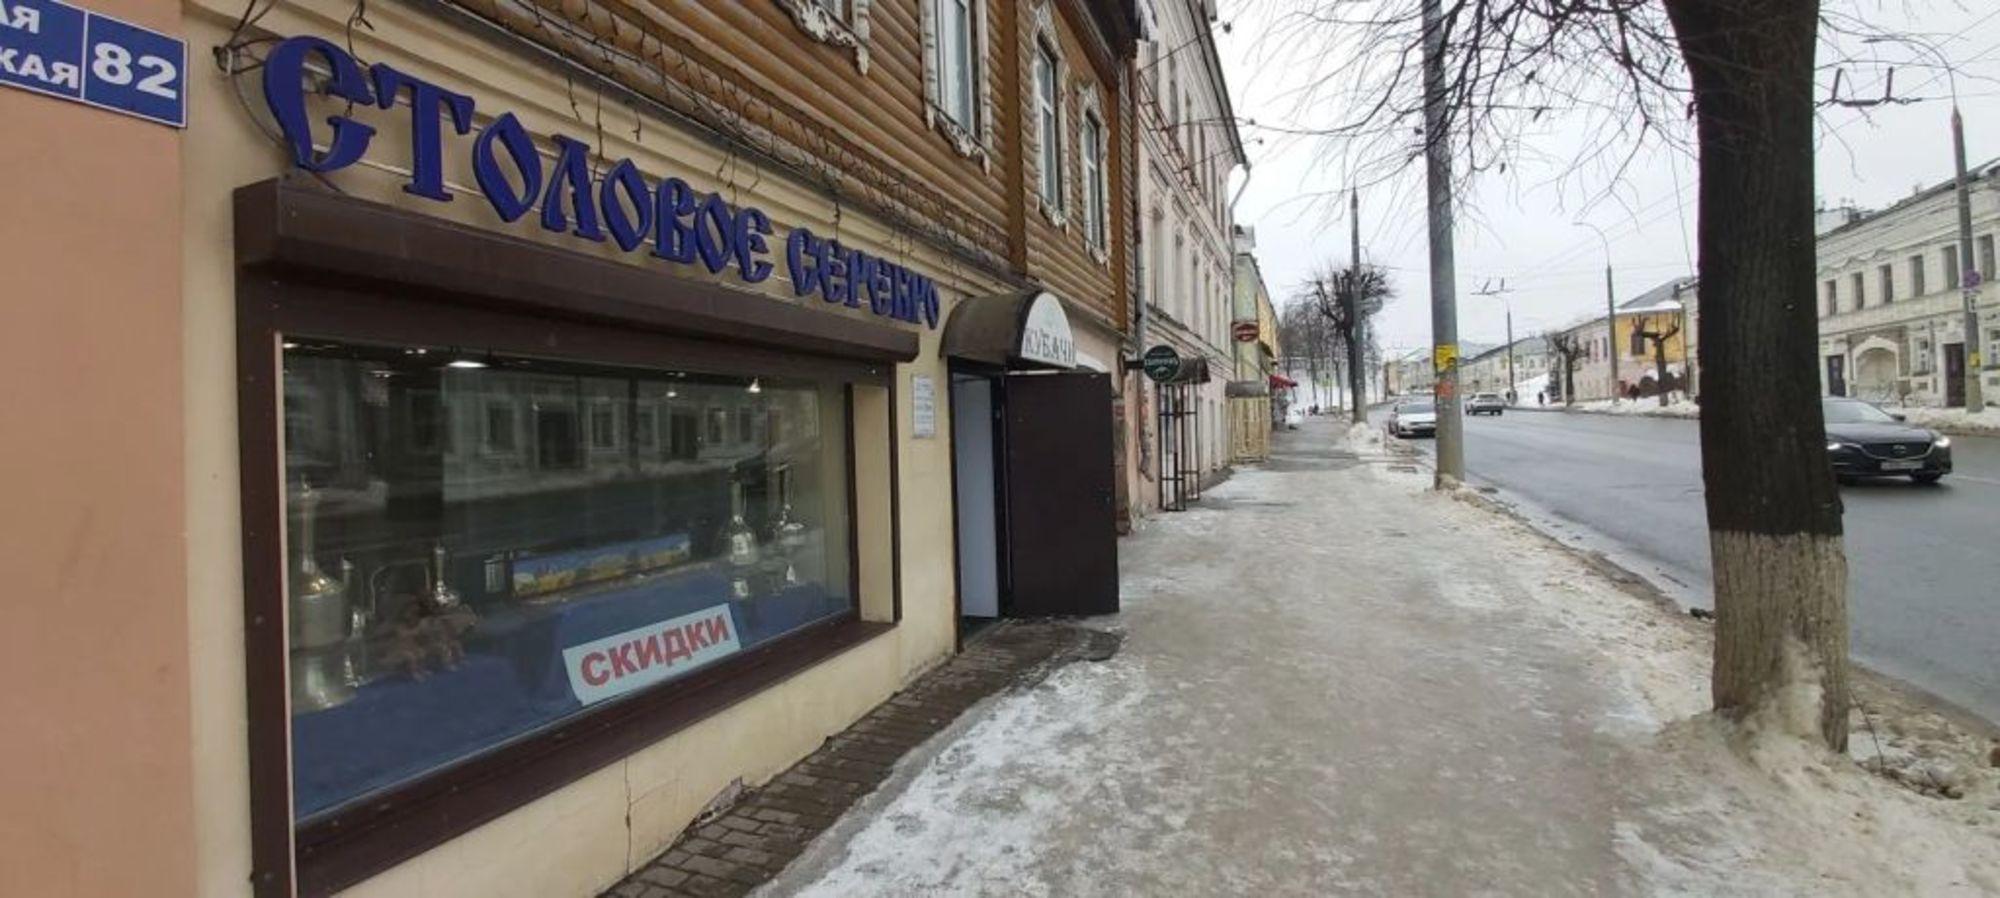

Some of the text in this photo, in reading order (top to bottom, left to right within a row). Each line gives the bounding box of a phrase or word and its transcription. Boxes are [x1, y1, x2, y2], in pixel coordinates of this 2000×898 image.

[93, 42, 177, 100] 82
[264, 35, 940, 330] СТОЛОВОЕ СЕРЕБРО
[580, 614, 730, 686] СКИДКИ
